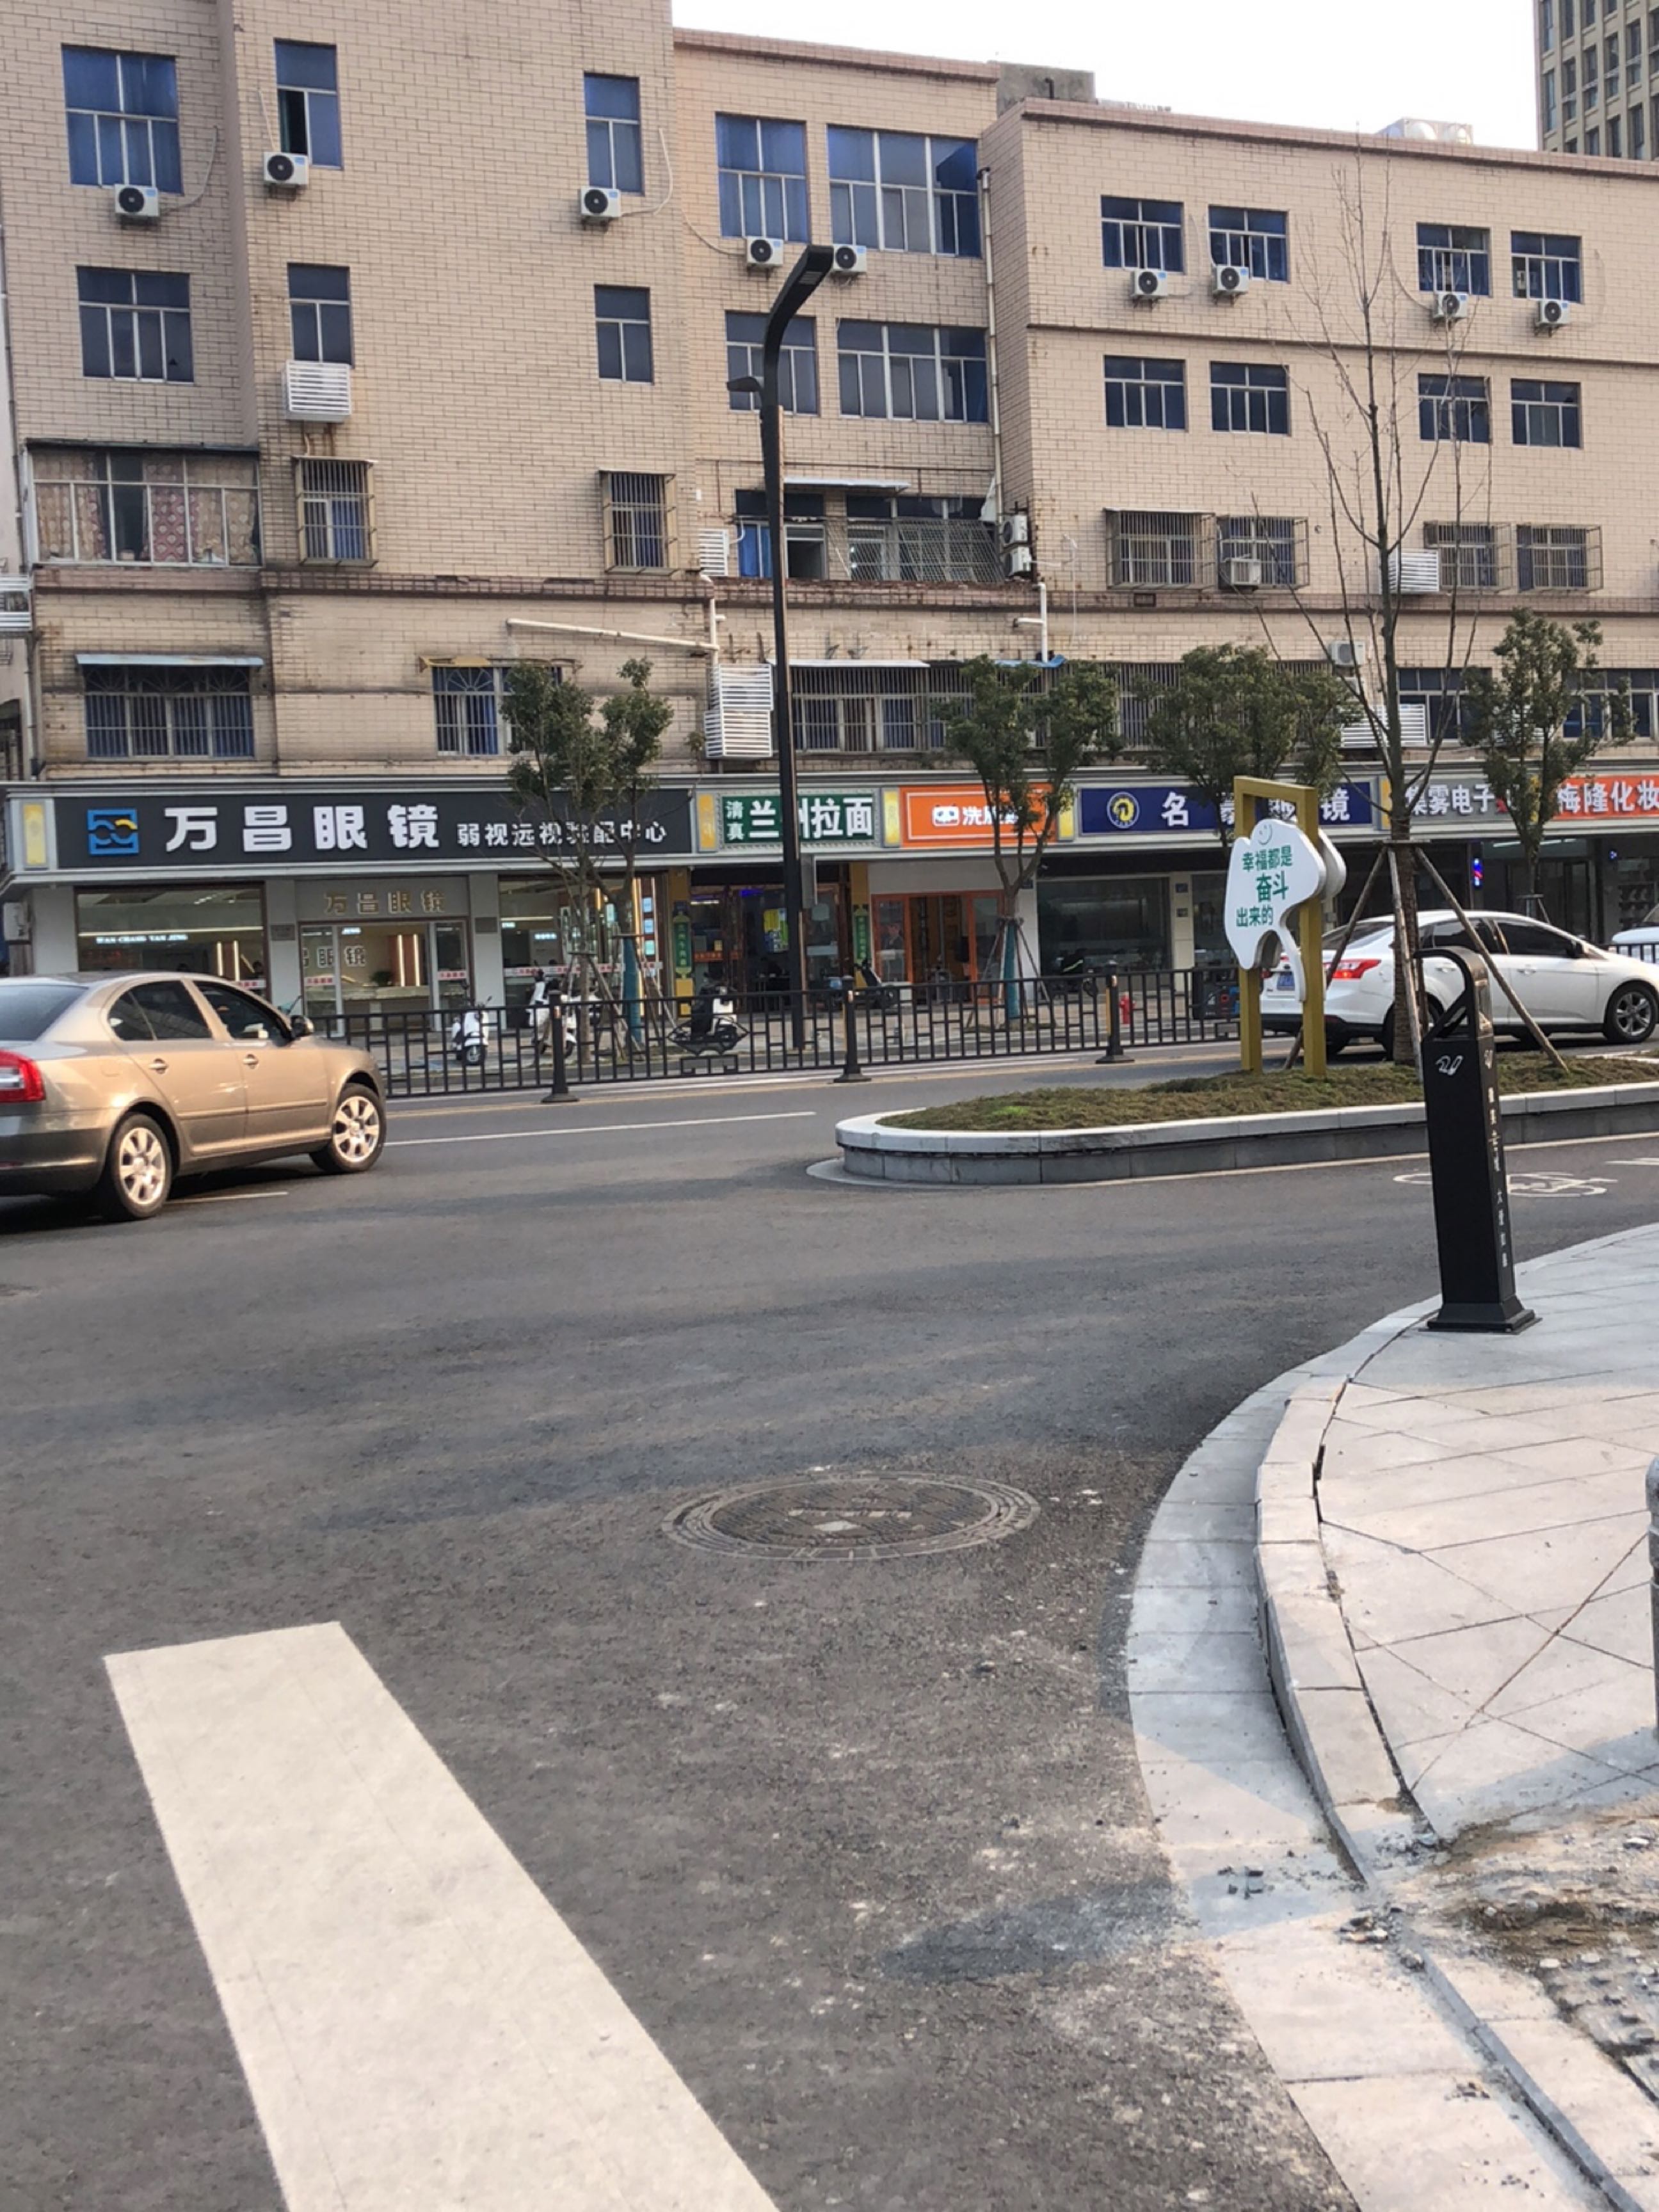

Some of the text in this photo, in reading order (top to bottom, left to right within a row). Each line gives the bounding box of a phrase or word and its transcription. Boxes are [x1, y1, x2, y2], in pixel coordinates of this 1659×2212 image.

[164, 805, 440, 852] 万昌眼镜
[725, 801, 745, 841] 清真
[1242, 845, 1292, 872] 幸福都是
[1256, 870, 1289, 902] 奋斗
[1236, 904, 1273, 927] 出来的
